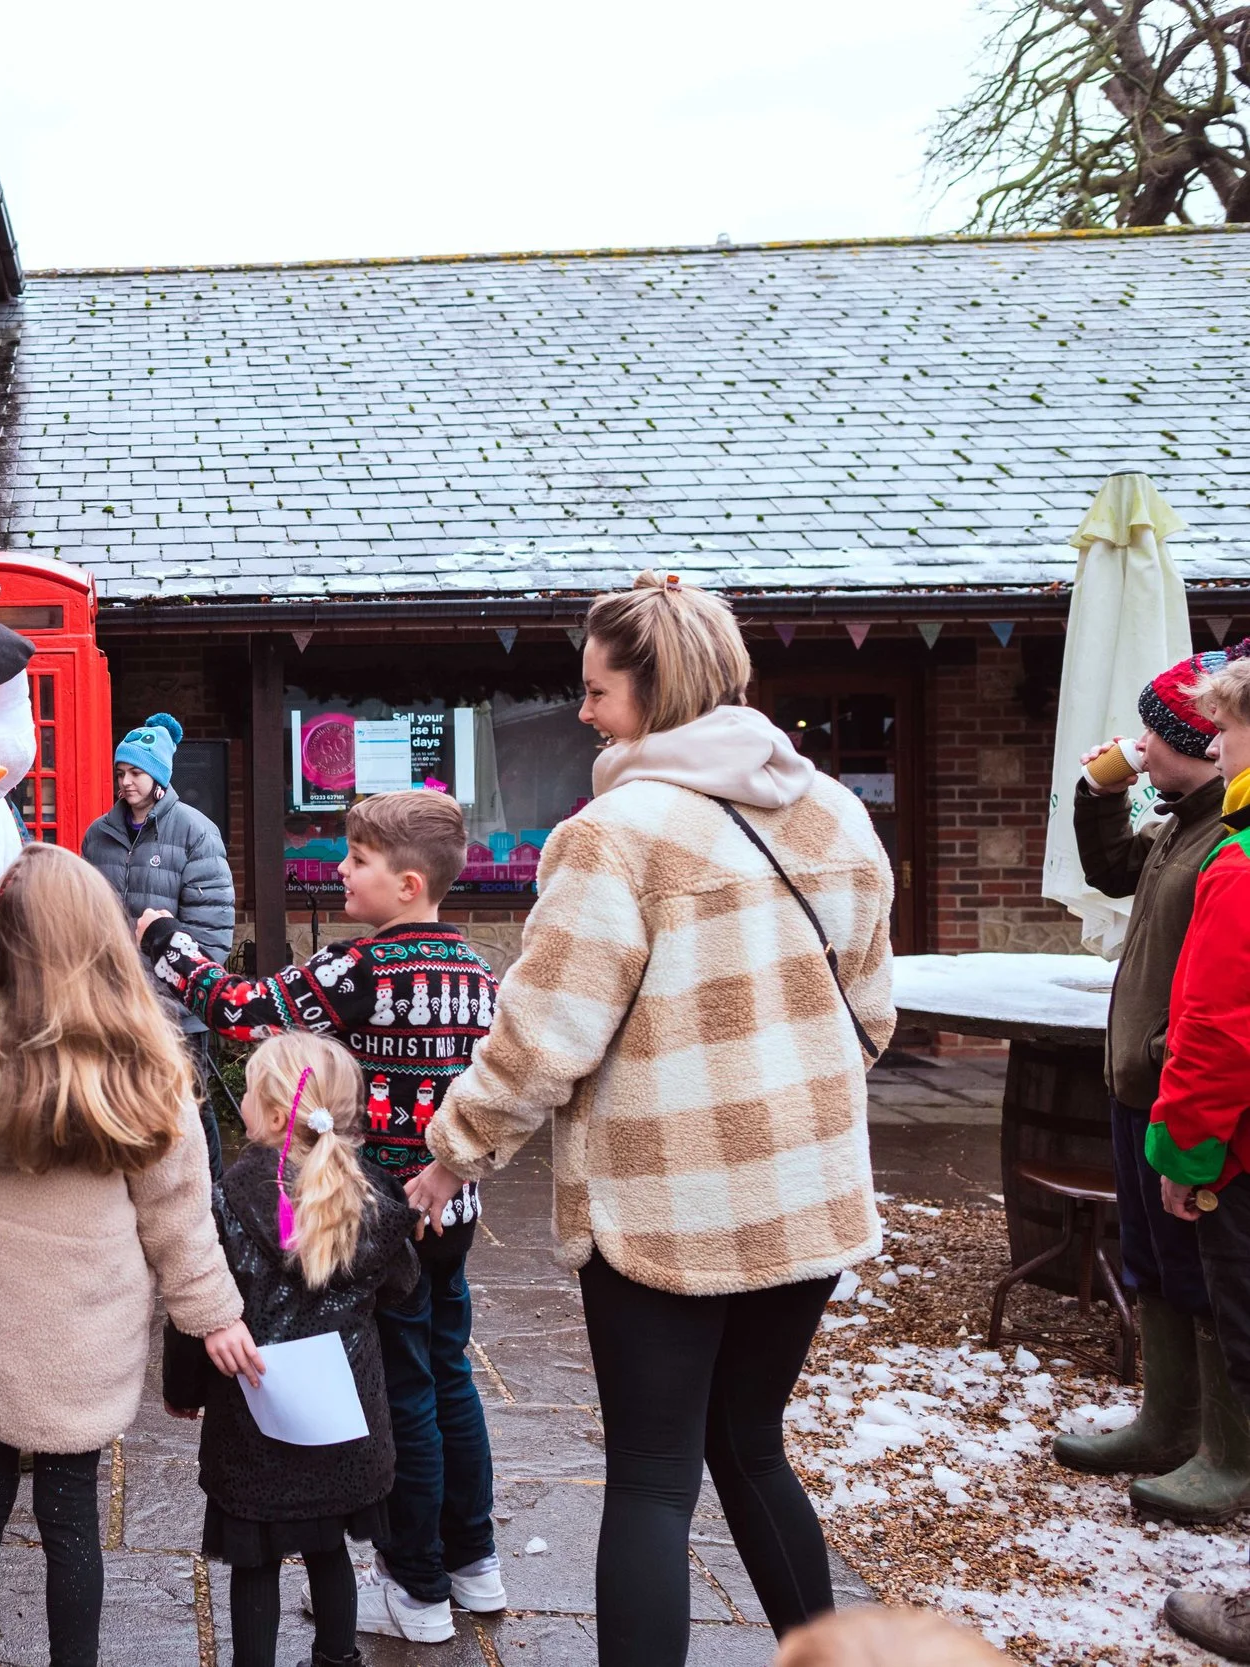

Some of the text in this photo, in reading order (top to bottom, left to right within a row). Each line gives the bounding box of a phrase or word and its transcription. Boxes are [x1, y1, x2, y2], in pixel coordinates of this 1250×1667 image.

[392, 712, 444, 725] Sell your
[432, 724, 443, 735] in
[412, 737, 440, 749] days
[294, 991, 338, 1035] LOA
[350, 1032, 457, 1059] CHRISTMAS
